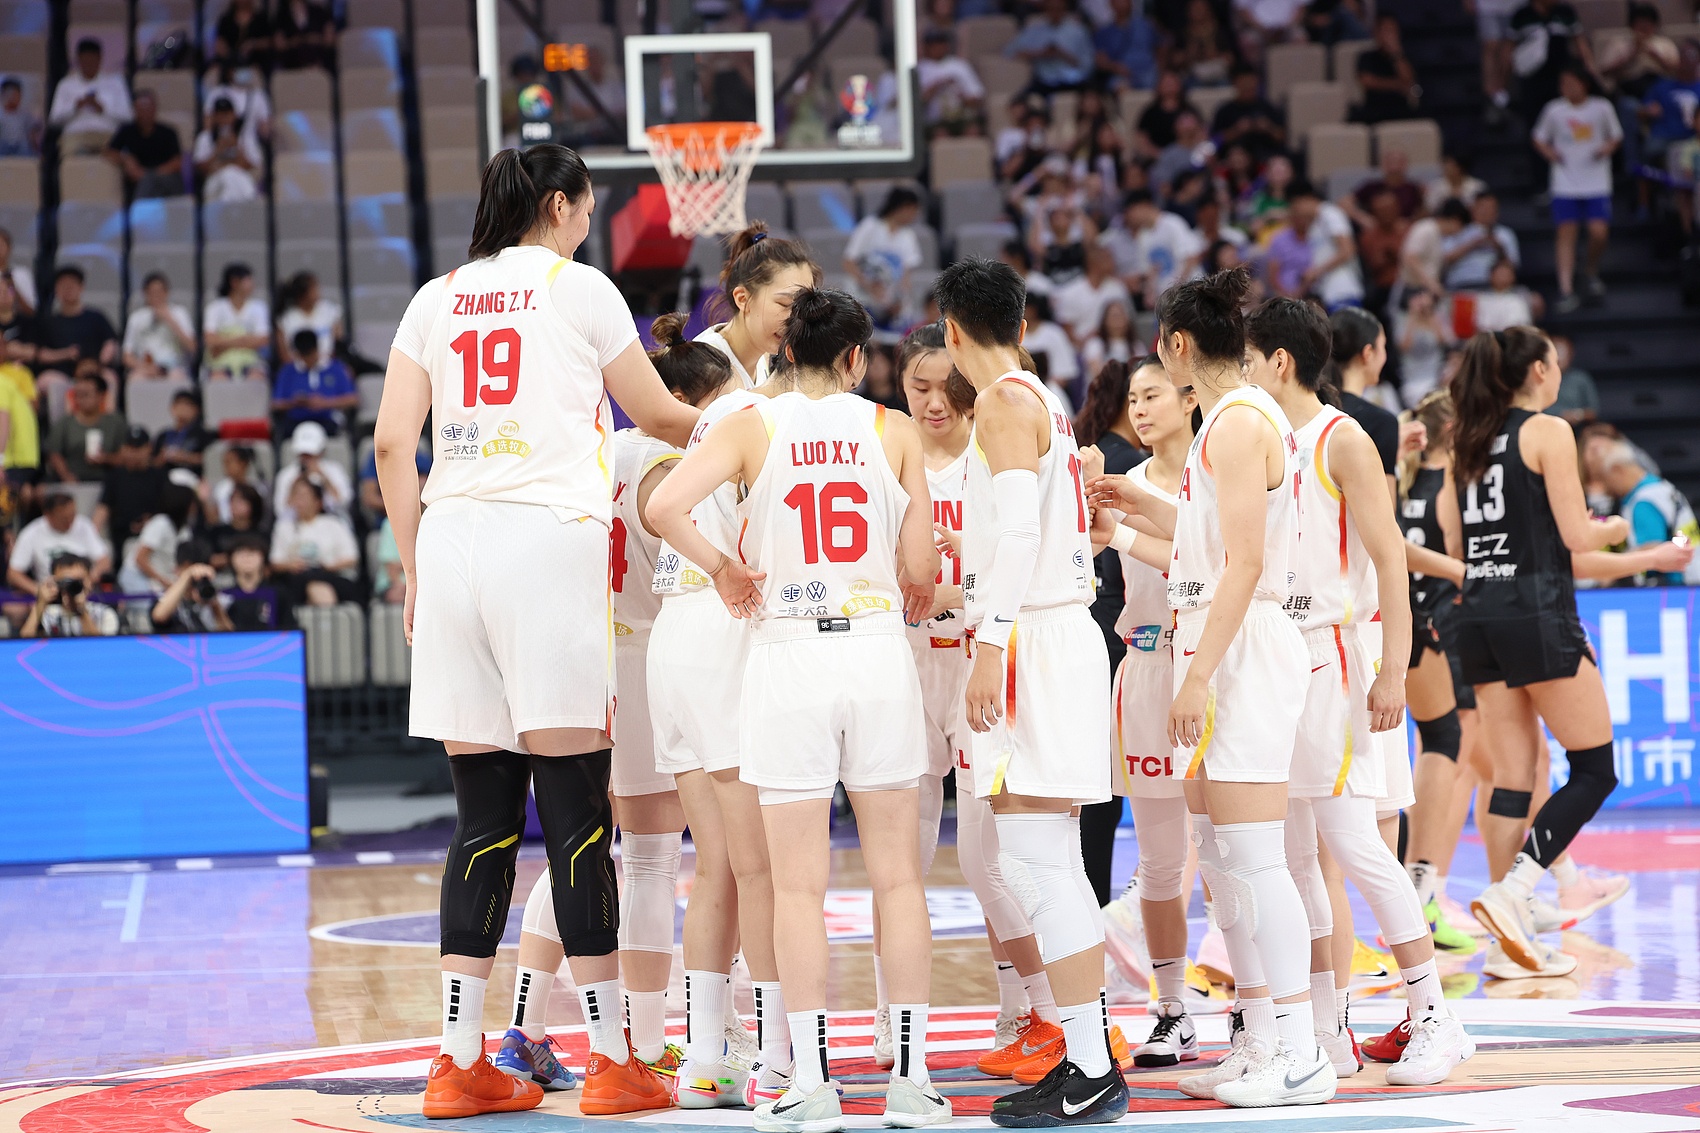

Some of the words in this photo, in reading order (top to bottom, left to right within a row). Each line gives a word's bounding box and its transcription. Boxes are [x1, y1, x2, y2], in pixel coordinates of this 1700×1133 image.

[452, 291, 505, 316] ZHANG
[508, 289, 537, 313] Z.Y.
[449, 327, 522, 408] 19
[791, 440, 826, 467] LUO
[832, 440, 865, 467] X.Y.
[1462, 463, 1506, 525] 13
[783, 481, 868, 565] 16
[1126, 754, 1174, 778] TCL
